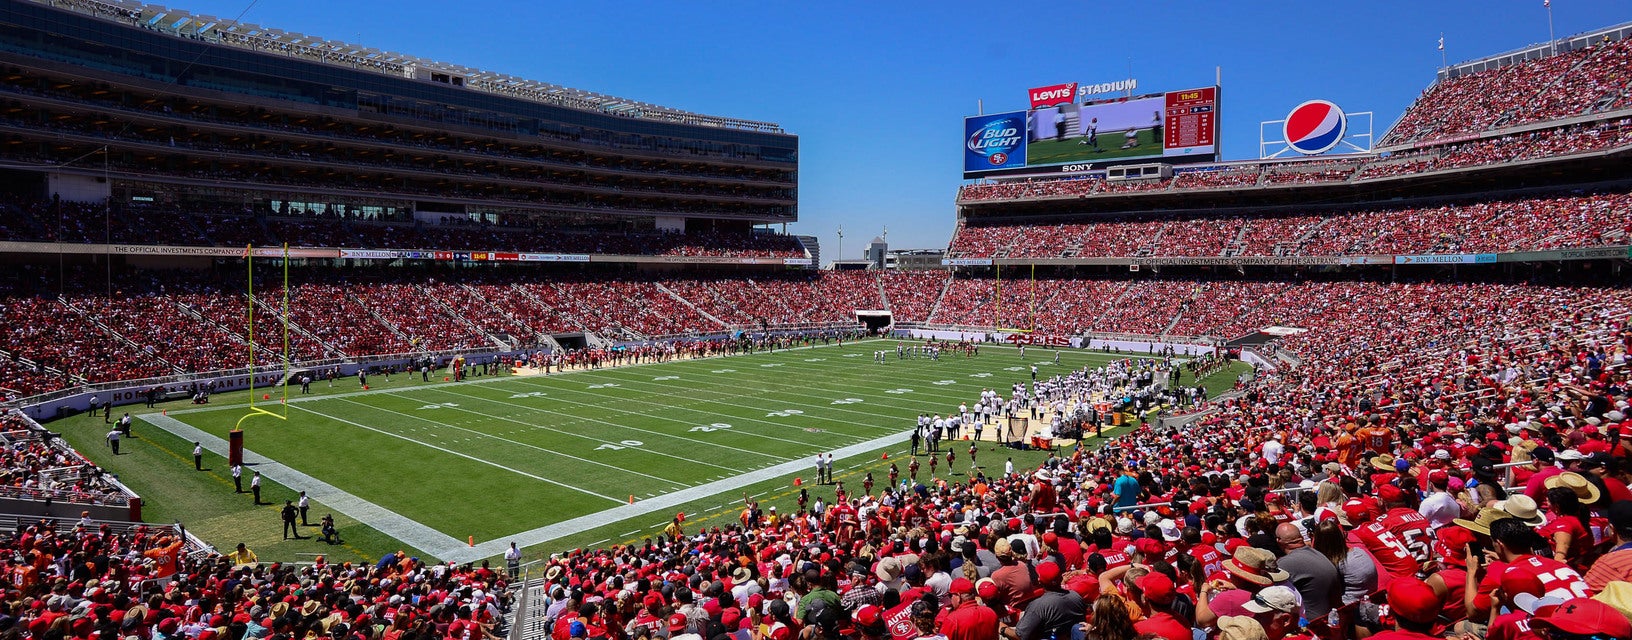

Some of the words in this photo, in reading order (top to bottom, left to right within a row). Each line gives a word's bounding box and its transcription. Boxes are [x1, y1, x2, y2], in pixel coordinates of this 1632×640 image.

[1079, 79, 1137, 96] STADIUM
[983, 128, 1017, 139] BUD
[974, 136, 1022, 149] LIGHT
[1062, 163, 1093, 172] SONY
[1400, 512, 1425, 523] WILLIS
[158, 555, 171, 565] 80
[1104, 553, 1125, 565] WILLIS
[14, 573, 23, 586] 18
